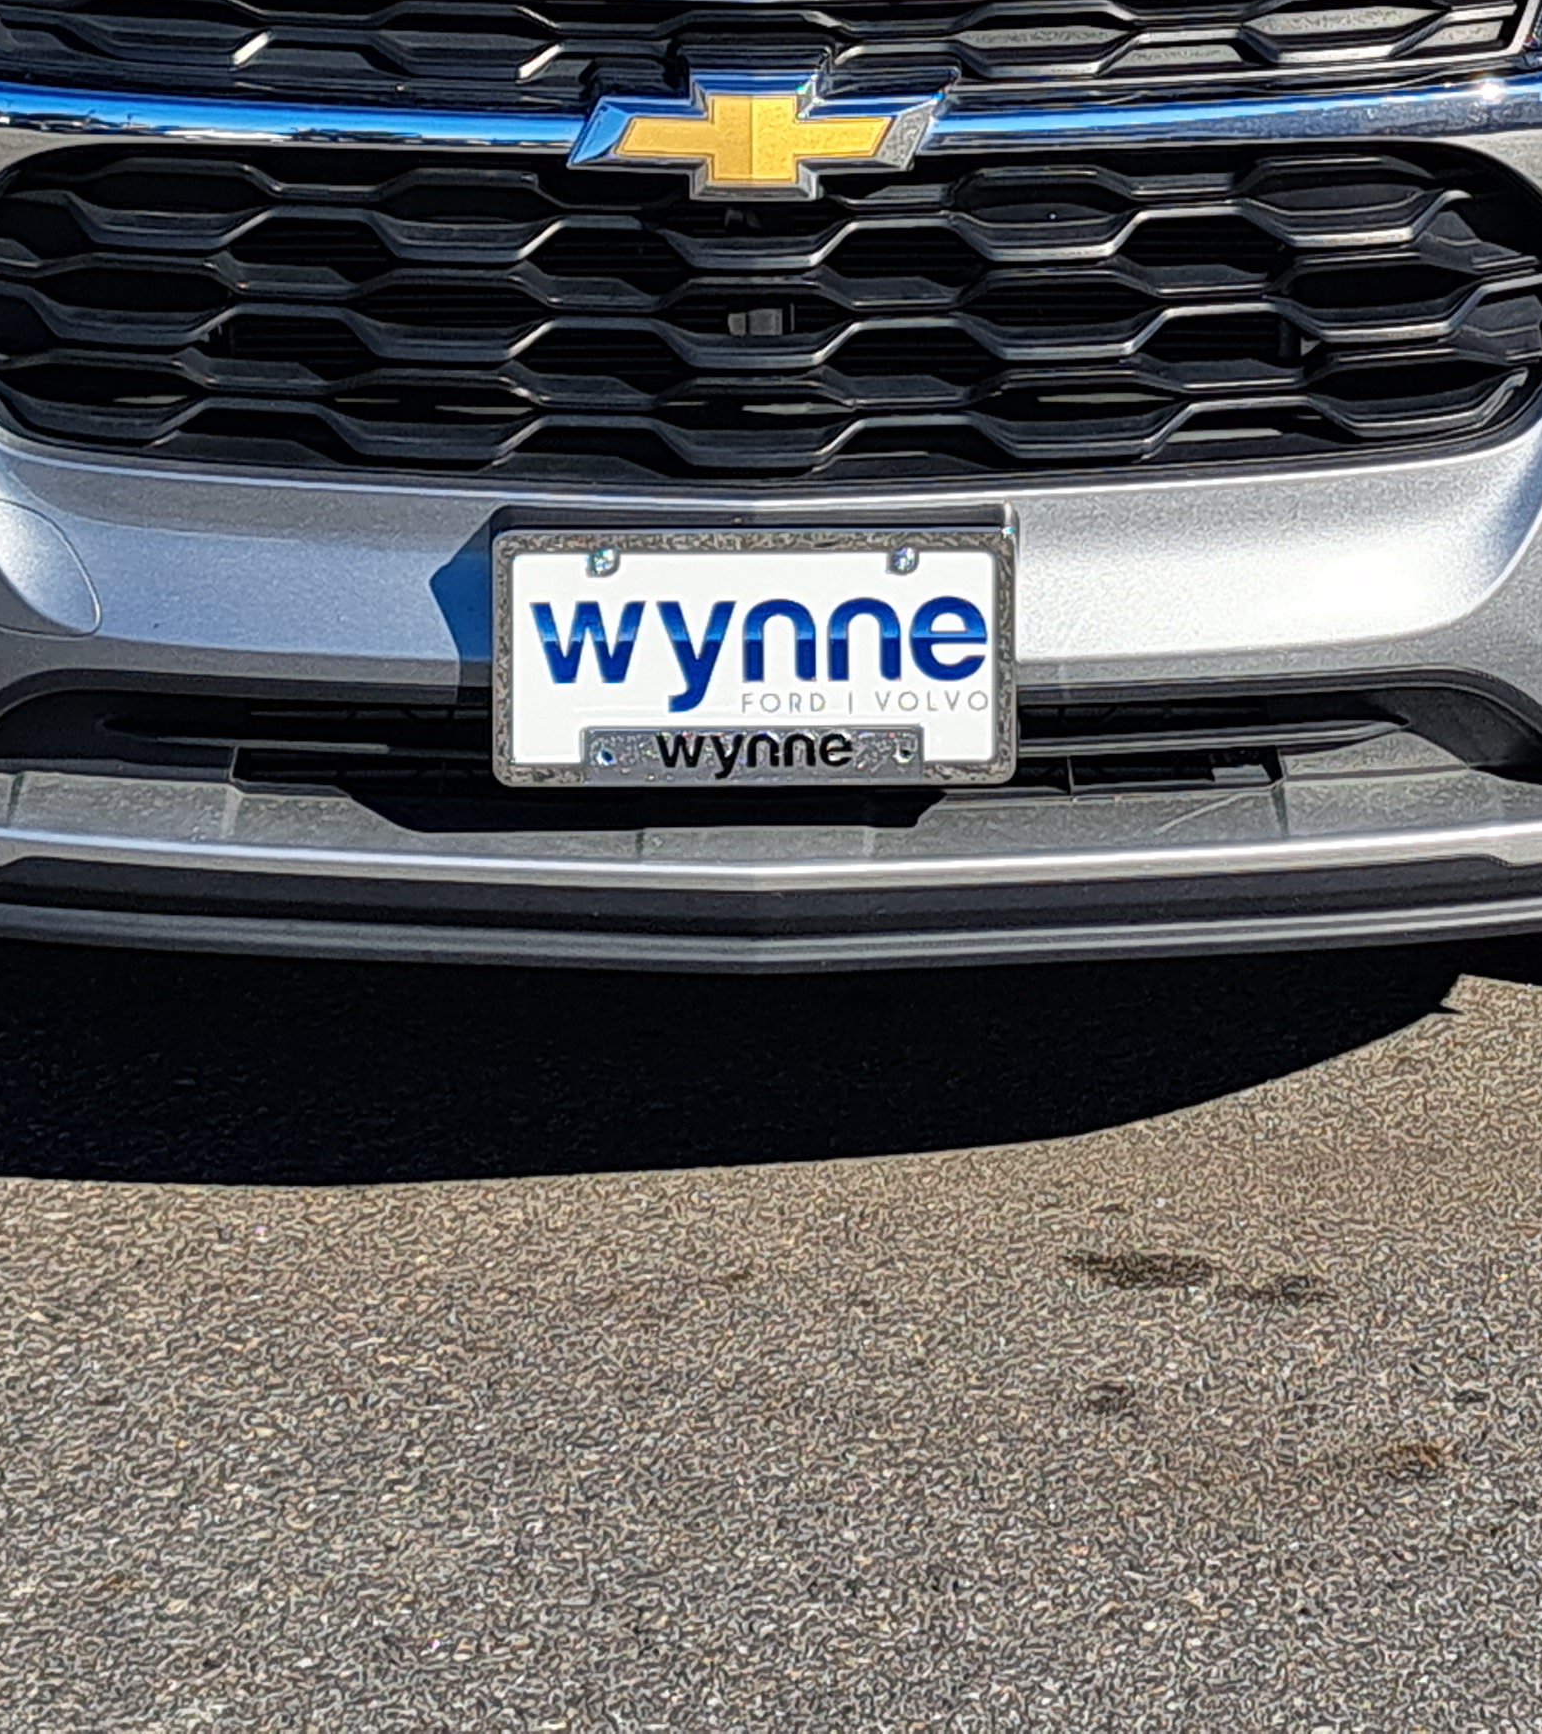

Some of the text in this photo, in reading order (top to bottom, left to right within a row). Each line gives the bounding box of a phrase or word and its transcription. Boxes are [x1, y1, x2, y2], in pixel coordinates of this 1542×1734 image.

[529, 595, 989, 714] wynne
[741, 692, 828, 714] FORD
[875, 689, 990, 713] VOLVO
[654, 731, 854, 780] wynne
